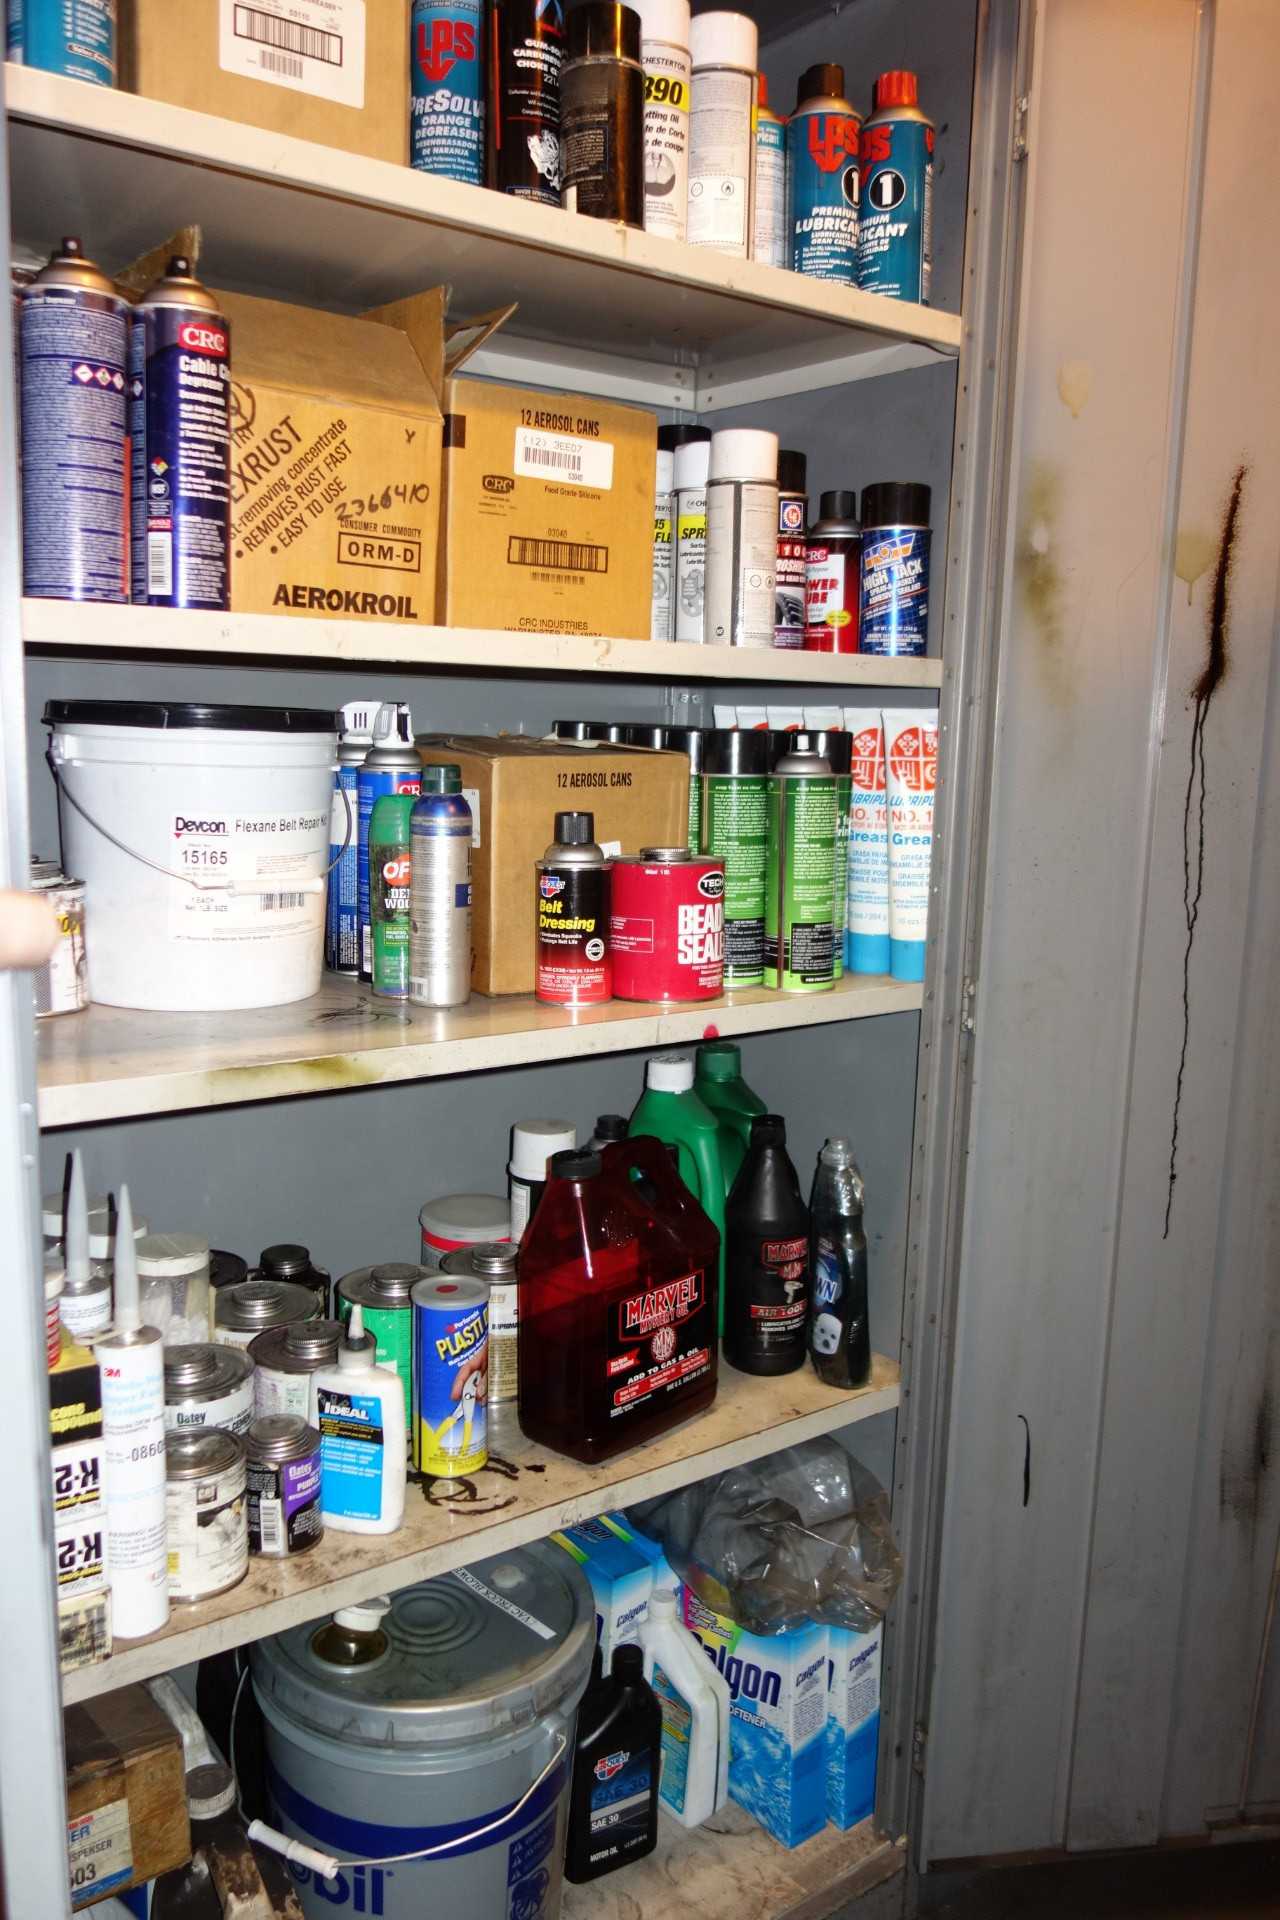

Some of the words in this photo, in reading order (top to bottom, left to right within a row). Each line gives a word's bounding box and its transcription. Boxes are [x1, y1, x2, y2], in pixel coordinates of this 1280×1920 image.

[417, 18, 476, 82] LPS
[421, 114, 471, 128] ORANGE
[415, 125, 478, 141] DEGREASER
[807, 114, 859, 173] LPS
[182, 326, 226, 353] CRC
[179, 355, 218, 378] Cable
[521, 408, 533, 425] 12
[534, 410, 575, 433] AEROSOL
[576, 418, 599, 437] CANS
[287, 418, 348, 481] concentrate
[242, 494, 299, 552] REMOVES
[294, 464, 327, 503] RUST
[324, 437, 352, 475] FAST
[484, 477, 512, 492] CRC
[276, 515, 309, 548] EASY
[305, 500, 326, 520] TO
[322, 474, 347, 504] USE
[339, 518, 378, 533] CONSUMER
[382, 523, 422, 538] COMMODITY
[348, 540, 415, 564] ORM-D
[863, 569, 889, 592] HIGH
[891, 559, 922, 581] TACK
[272, 583, 418, 619] AEROKROIL
[519, 617, 538, 628] CRC
[540, 619, 589, 631] INDUSTRIES
[557, 774, 567, 787] 12
[570, 772, 607, 787] AEROSOL
[610, 772, 632, 786] CANS
[175, 817, 226, 833] Devcon
[235, 819, 276, 833] Flexane
[279, 818, 297, 832] Belt
[299, 818, 320, 831] Repair
[182, 850, 228, 864] 15165
[539, 899, 563, 914] Belt
[539, 915, 596, 932] Dressing
[678, 902, 723, 936] BEAD
[626, 1275, 698, 1328] MARVEL
[436, 1316, 482, 1361] PLASTI
[627, 1372, 645, 1384] ADD
[648, 1366, 658, 1374] TO
[661, 1357, 676, 1369] GAS
[177, 1413, 206, 1426] Oatey
[324, 1402, 370, 1420] IDEAL
[591, 1818, 606, 1830] SAE
[608, 1814, 619, 1824] 30
